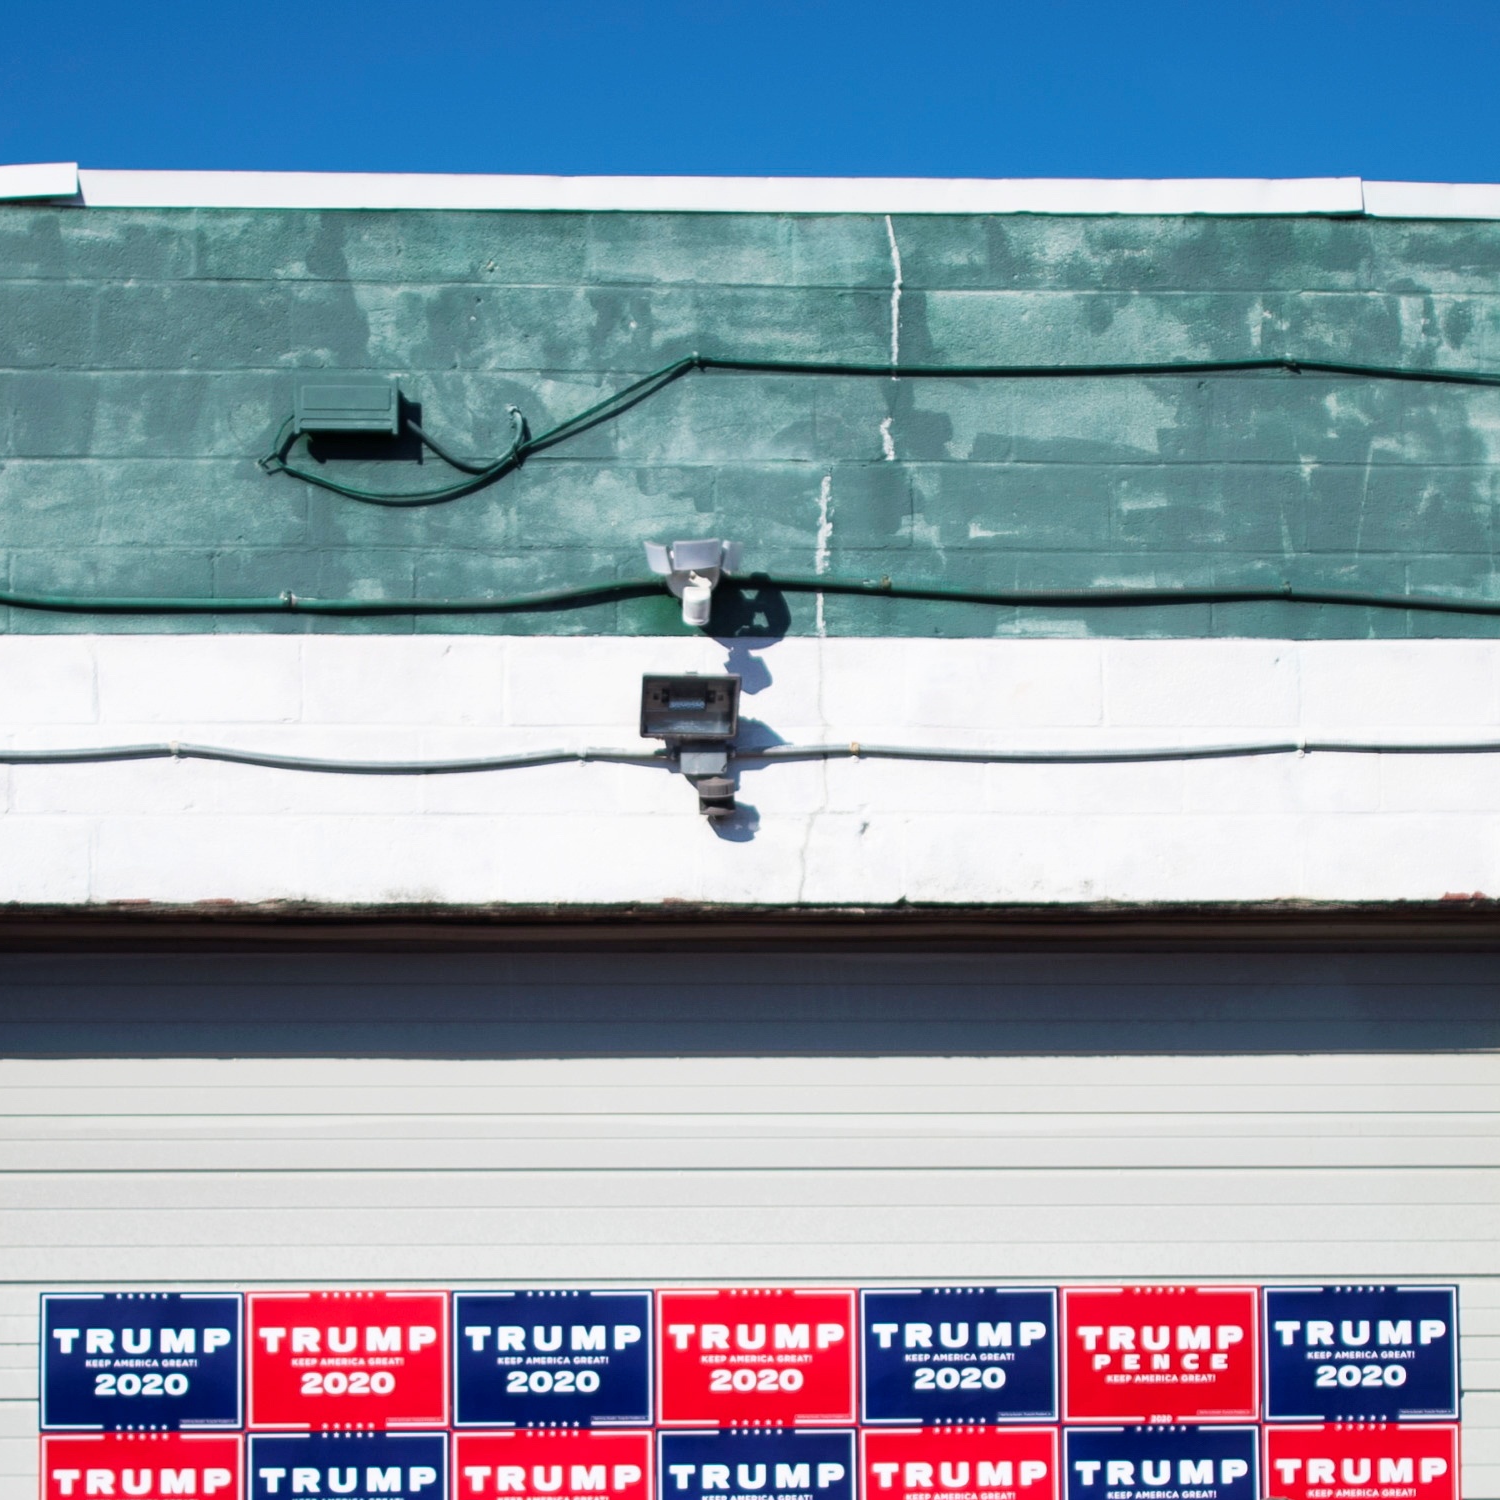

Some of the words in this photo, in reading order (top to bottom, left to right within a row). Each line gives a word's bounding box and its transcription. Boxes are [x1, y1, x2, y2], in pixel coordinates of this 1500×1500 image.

[52, 1327, 231, 1355] TRUMP
[258, 1325, 437, 1354] TRUMP
[464, 1324, 642, 1352] TRUMP
[667, 1323, 845, 1351] TRUMP
[871, 1321, 1047, 1349] TRUMP
[1076, 1325, 1244, 1351] TRUMP
[1274, 1319, 1447, 1347] TRUMP
[85, 1358, 112, 1369] KEEP
[113, 1358, 159, 1369] AMERICA
[161, 1358, 198, 1369] GREAT!
[291, 1356, 318, 1367] KEEP
[319, 1356, 366, 1367] AMERICA
[367, 1356, 404, 1367] GREAT!
[496, 1355, 524, 1366] KEEP
[525, 1355, 571, 1366] AMERICA
[572, 1355, 609, 1366] GREAT!
[700, 1354, 727, 1364] KEEP
[728, 1354, 775, 1364] AMERICA
[776, 1354, 813, 1364] GREAT!
[904, 1352, 931, 1363] KEEP
[932, 1352, 978, 1363] AMERICA
[979, 1352, 1015, 1363] GREAT!
[1092, 1353, 1228, 1371] PENCE
[1306, 1350, 1333, 1360] KEEP
[1334, 1350, 1379, 1360] AMERICA
[1380, 1350, 1416, 1360] GREAT!
[94, 1373, 189, 1397] 2020
[300, 1371, 396, 1395] 2020
[506, 1370, 600, 1394] 2020
[709, 1368, 804, 1392] 2020
[913, 1366, 1007, 1390] 2020
[1105, 1373, 1133, 1384] KEEP
[1134, 1373, 1179, 1384] AMERICA
[1315, 1364, 1407, 1388] 2020
[52, 1467, 232, 1496] TRUMP
[258, 1466, 437, 1494] TRUMP
[463, 1464, 642, 1493] TRUMP
[668, 1463, 845, 1490] TRUMP
[871, 1460, 1048, 1489] TRUMP
[1074, 1459, 1249, 1486] TRUMP
[1274, 1457, 1448, 1485] TRUMP
[1106, 1490, 1133, 1500] KEEP
[1134, 1490, 1180, 1500] AMERICA
[1181, 1490, 1217, 1500] GREAT!
[1307, 1488, 1334, 1498] KEEP
[1335, 1488, 1380, 1498] AMERICA
[1381, 1488, 1417, 1498] GREAT!
